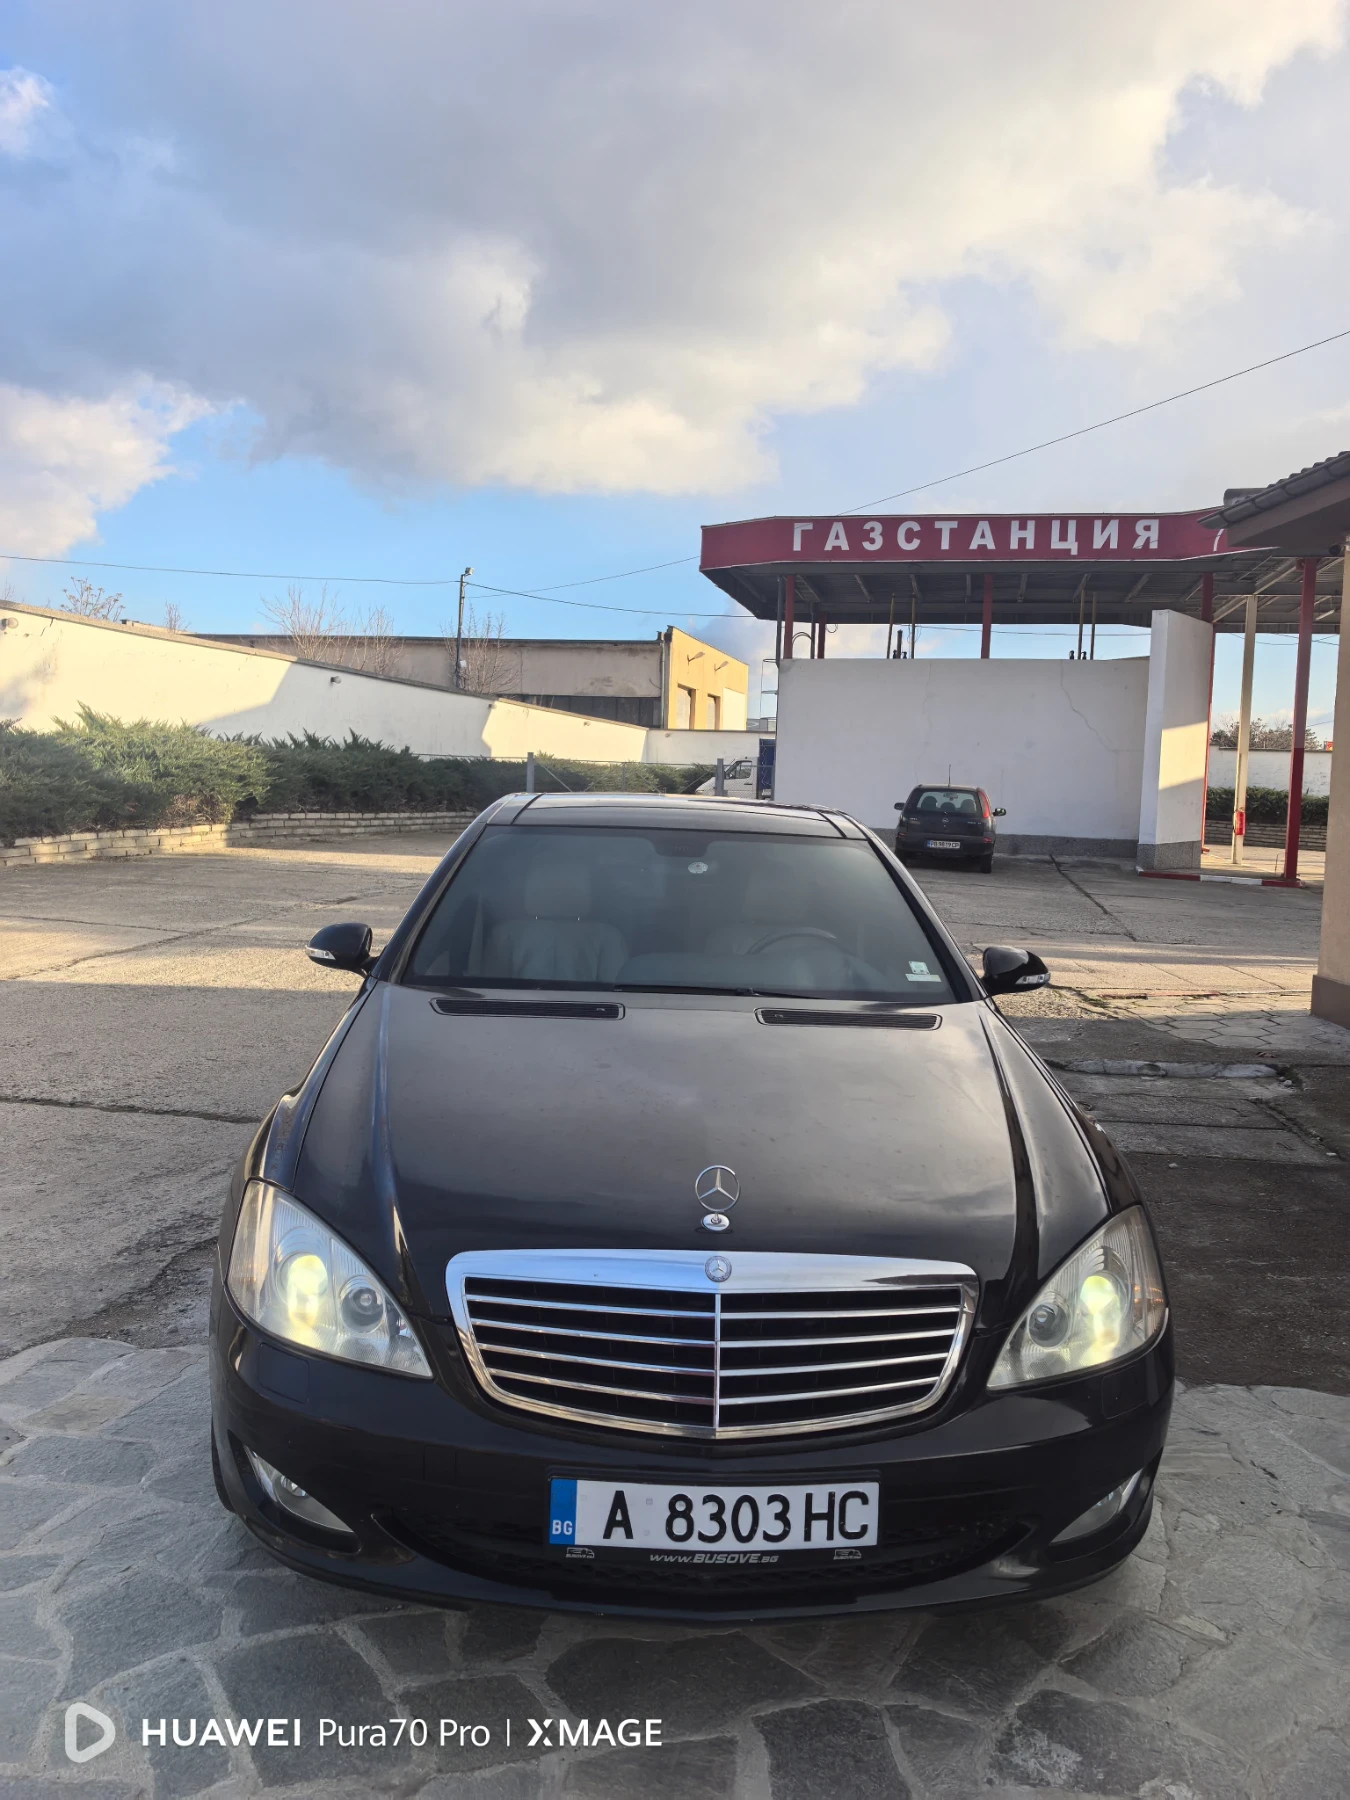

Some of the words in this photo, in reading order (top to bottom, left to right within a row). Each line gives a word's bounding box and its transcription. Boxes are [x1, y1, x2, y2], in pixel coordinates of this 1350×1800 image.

[792, 519, 1160, 556] ГАЗСТАНЦИЯ
[552, 1519, 573, 1536] BG
[602, 1490, 634, 1540] A
[665, 1493, 791, 1544] 8303
